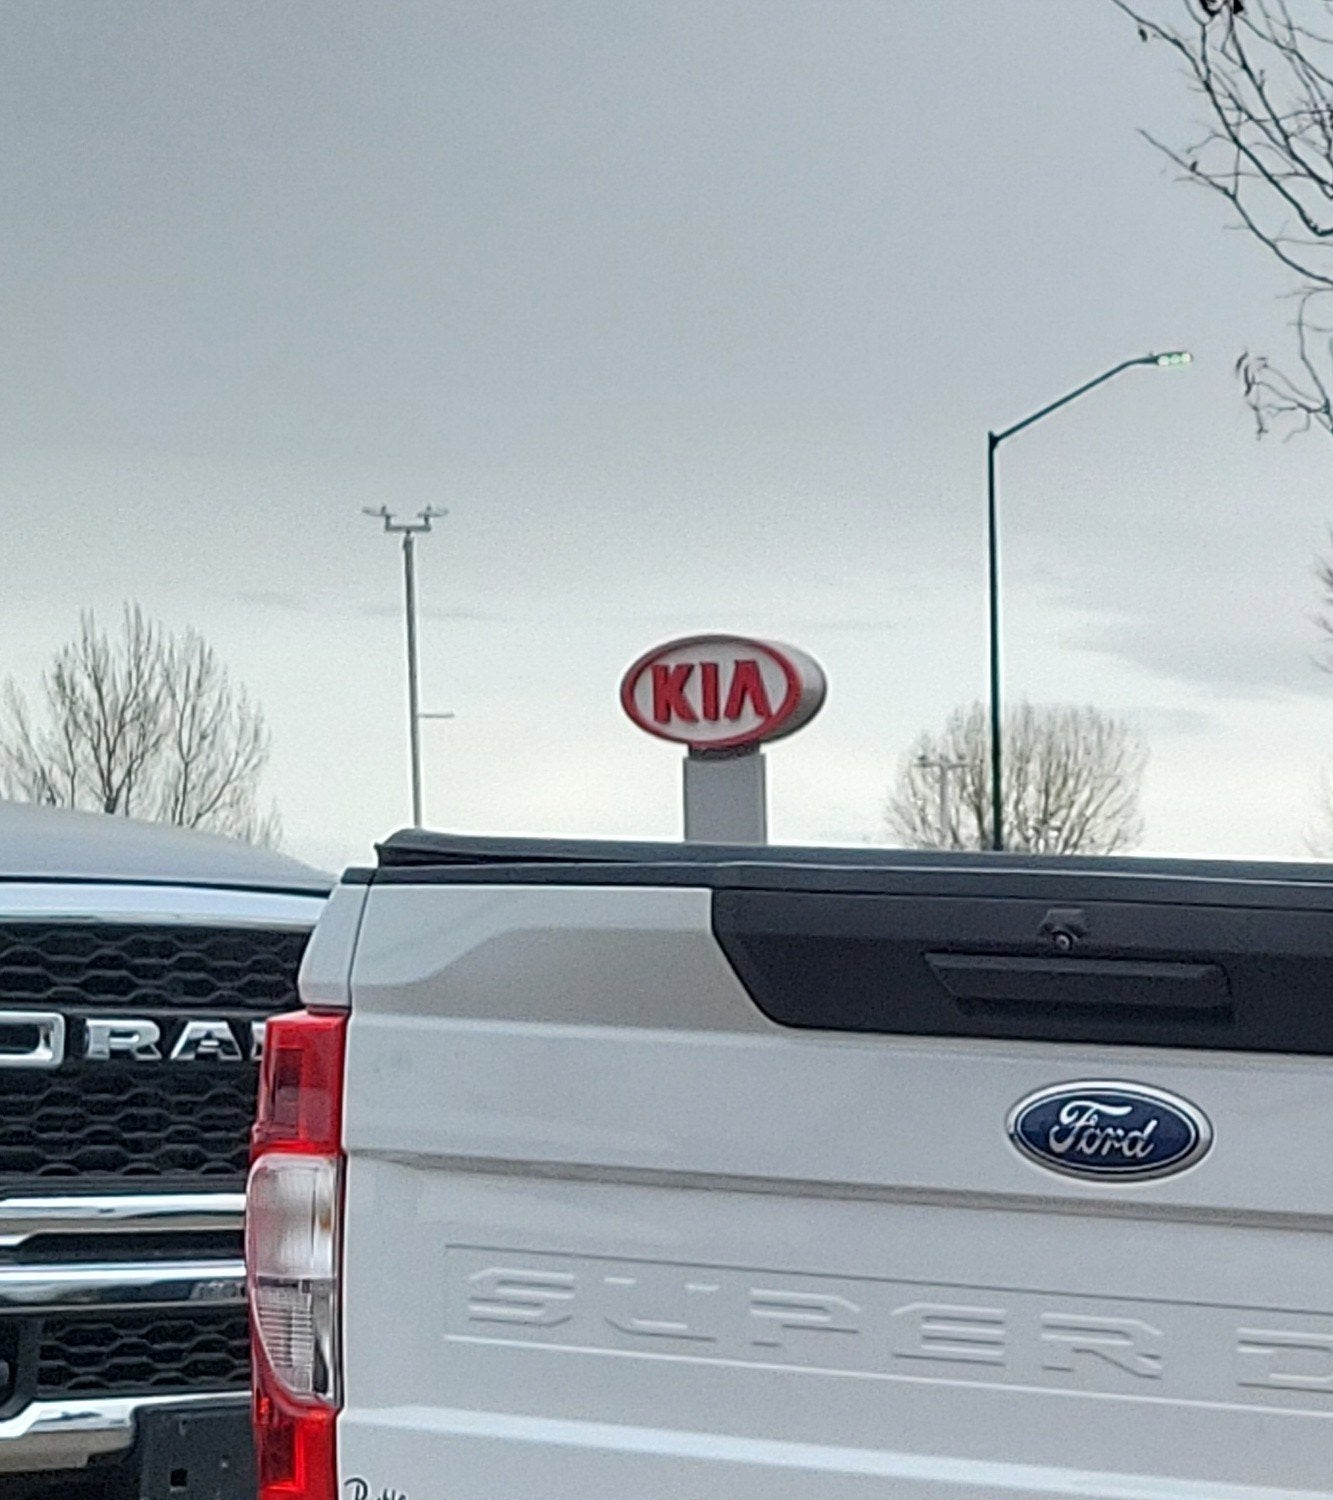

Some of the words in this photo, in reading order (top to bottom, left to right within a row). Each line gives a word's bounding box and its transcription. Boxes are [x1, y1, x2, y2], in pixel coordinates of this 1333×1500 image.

[652, 660, 774, 724] KIA
[84, 1017, 268, 1061] RA
[1048, 1101, 1158, 1158] Ford
[468, 1266, 1162, 1379] SUPER
